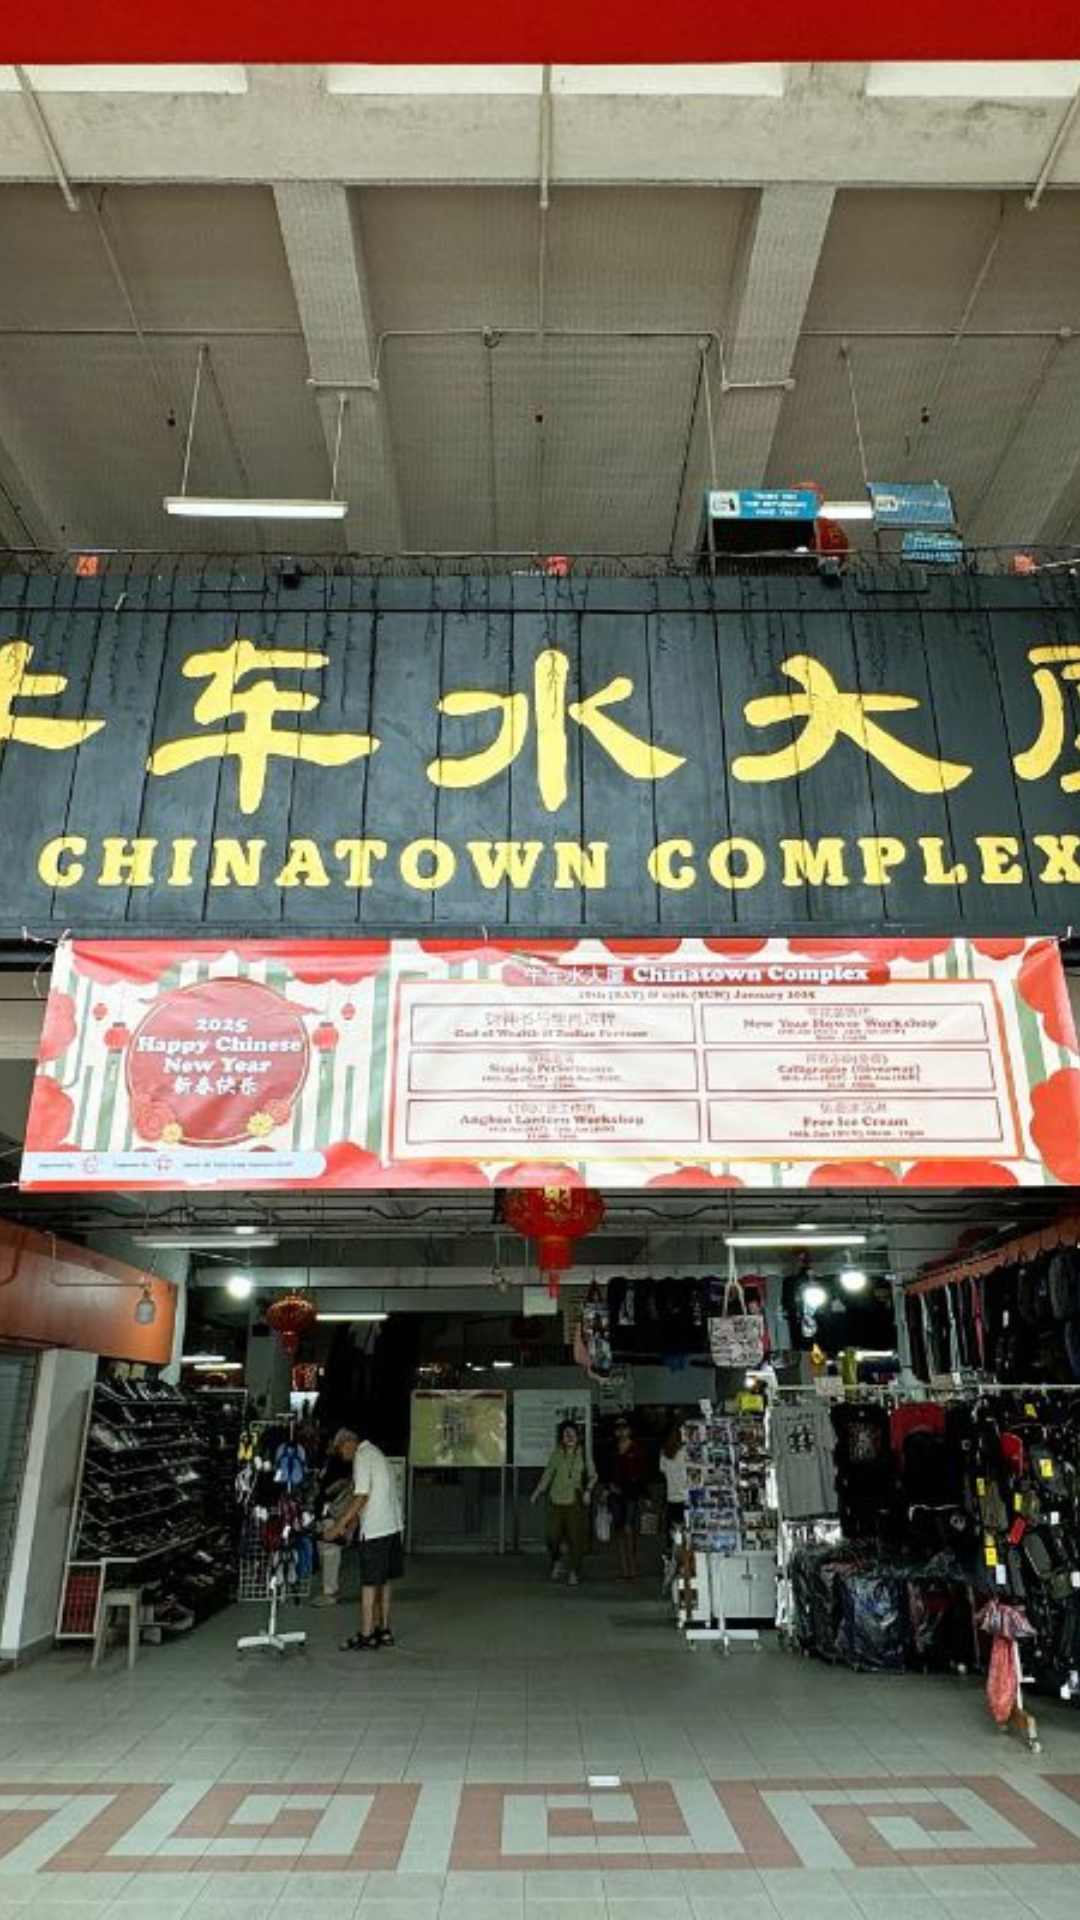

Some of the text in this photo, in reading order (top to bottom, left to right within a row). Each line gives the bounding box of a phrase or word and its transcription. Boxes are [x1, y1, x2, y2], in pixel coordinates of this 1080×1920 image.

[38, 836, 1080, 890] CHINATOWN COMPLEX
[632, 966, 869, 985] Chinatown Complex
[734, 990, 783, 1001] January
[196, 1018, 249, 1032] 2025
[744, 1018, 772, 1028] New
[864, 1018, 938, 1030] Workshop
[138, 1036, 302, 1054] Happy Chinese
[164, 1057, 272, 1073] New Year
[574, 1115, 644, 1127] Workshop
[803, 1115, 908, 1127] Free Ice Cream
